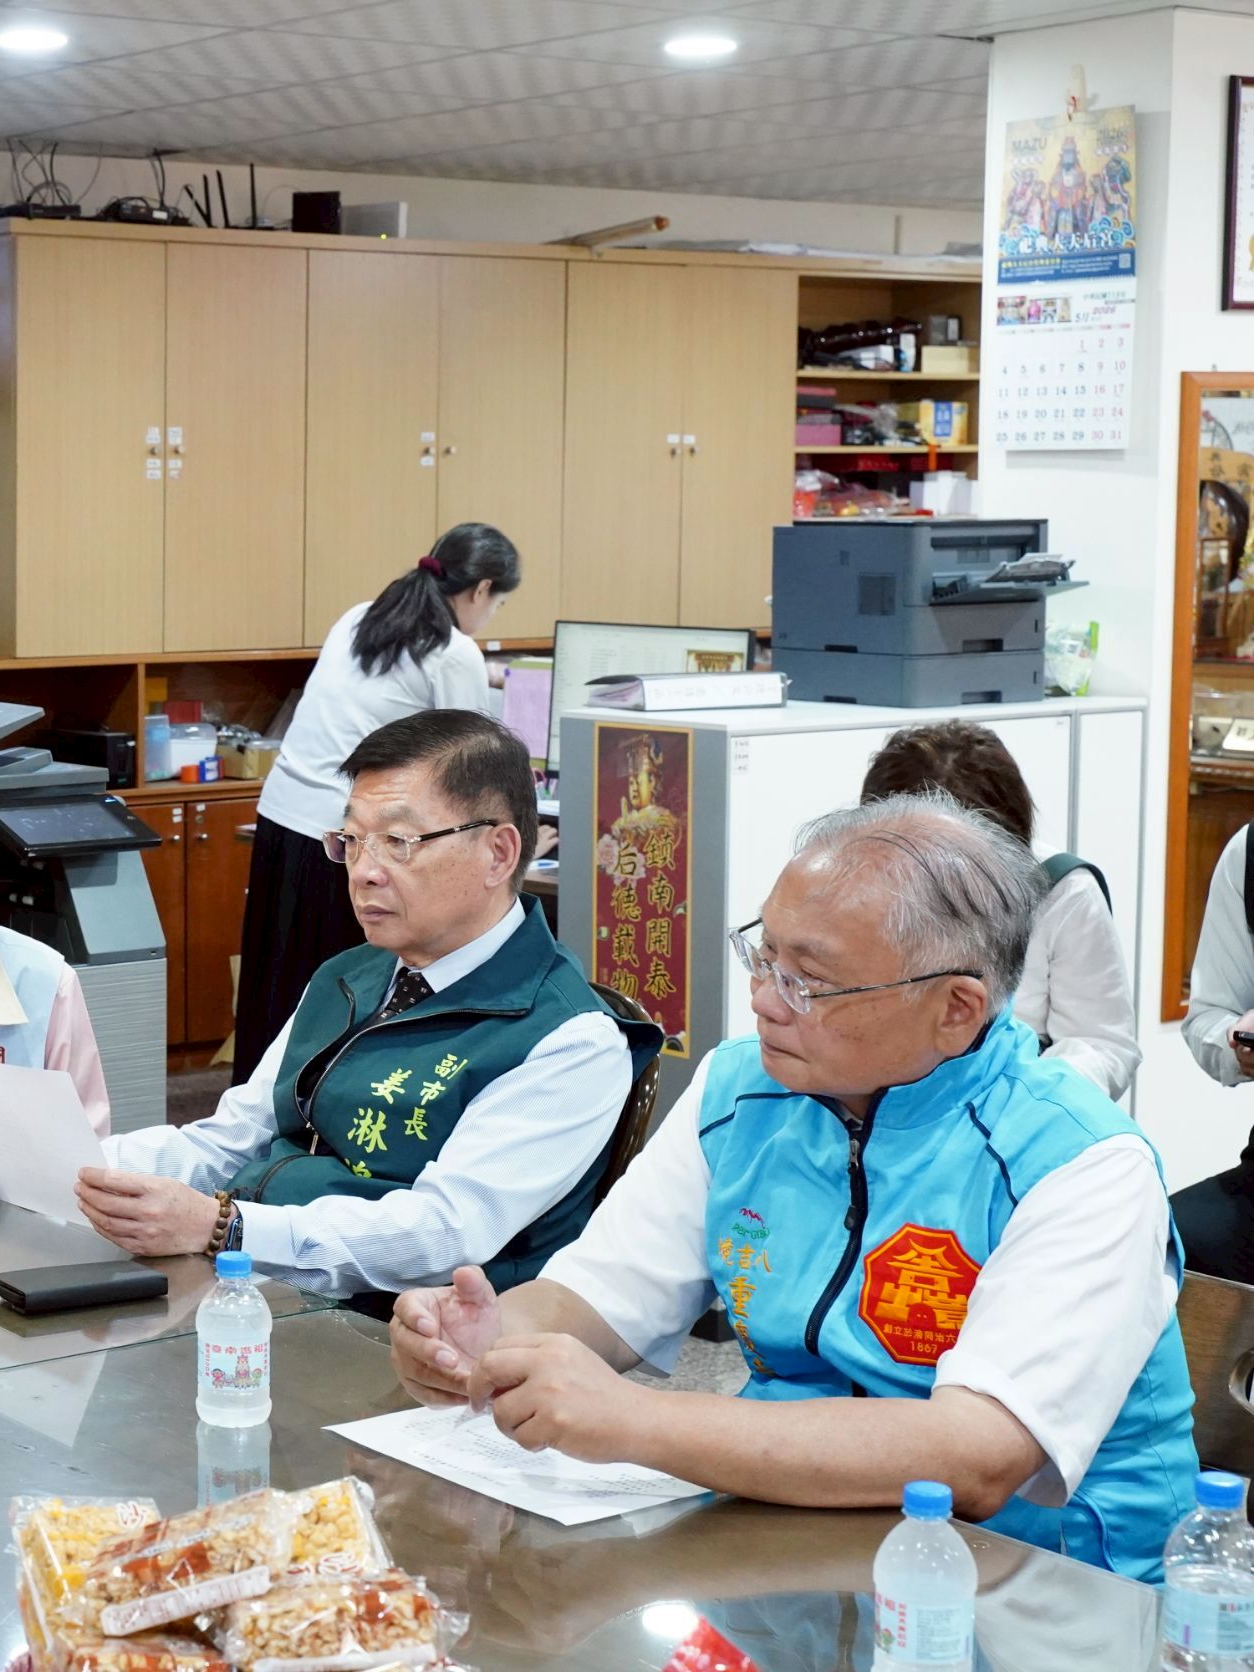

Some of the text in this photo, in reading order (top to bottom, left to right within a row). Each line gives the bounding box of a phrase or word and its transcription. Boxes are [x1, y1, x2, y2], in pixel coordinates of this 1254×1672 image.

[1080, 336, 1124, 350] 1 2 3
[1002, 360, 1126, 375] 4 5 6 7 8 9 10
[998, 383, 1125, 398] 11 12 13 14 15 16 17
[997, 407, 1124, 420] 18 19 20 21 22 23 24
[996, 430, 1123, 442] 25 26 27 28 29 30 31
[610, 842, 642, 1002] 后德載物
[645, 832, 677, 1000] 鎮南開泰
[403, 1053, 469, 1142] 副市長
[909, 1341, 939, 1355] 1867
